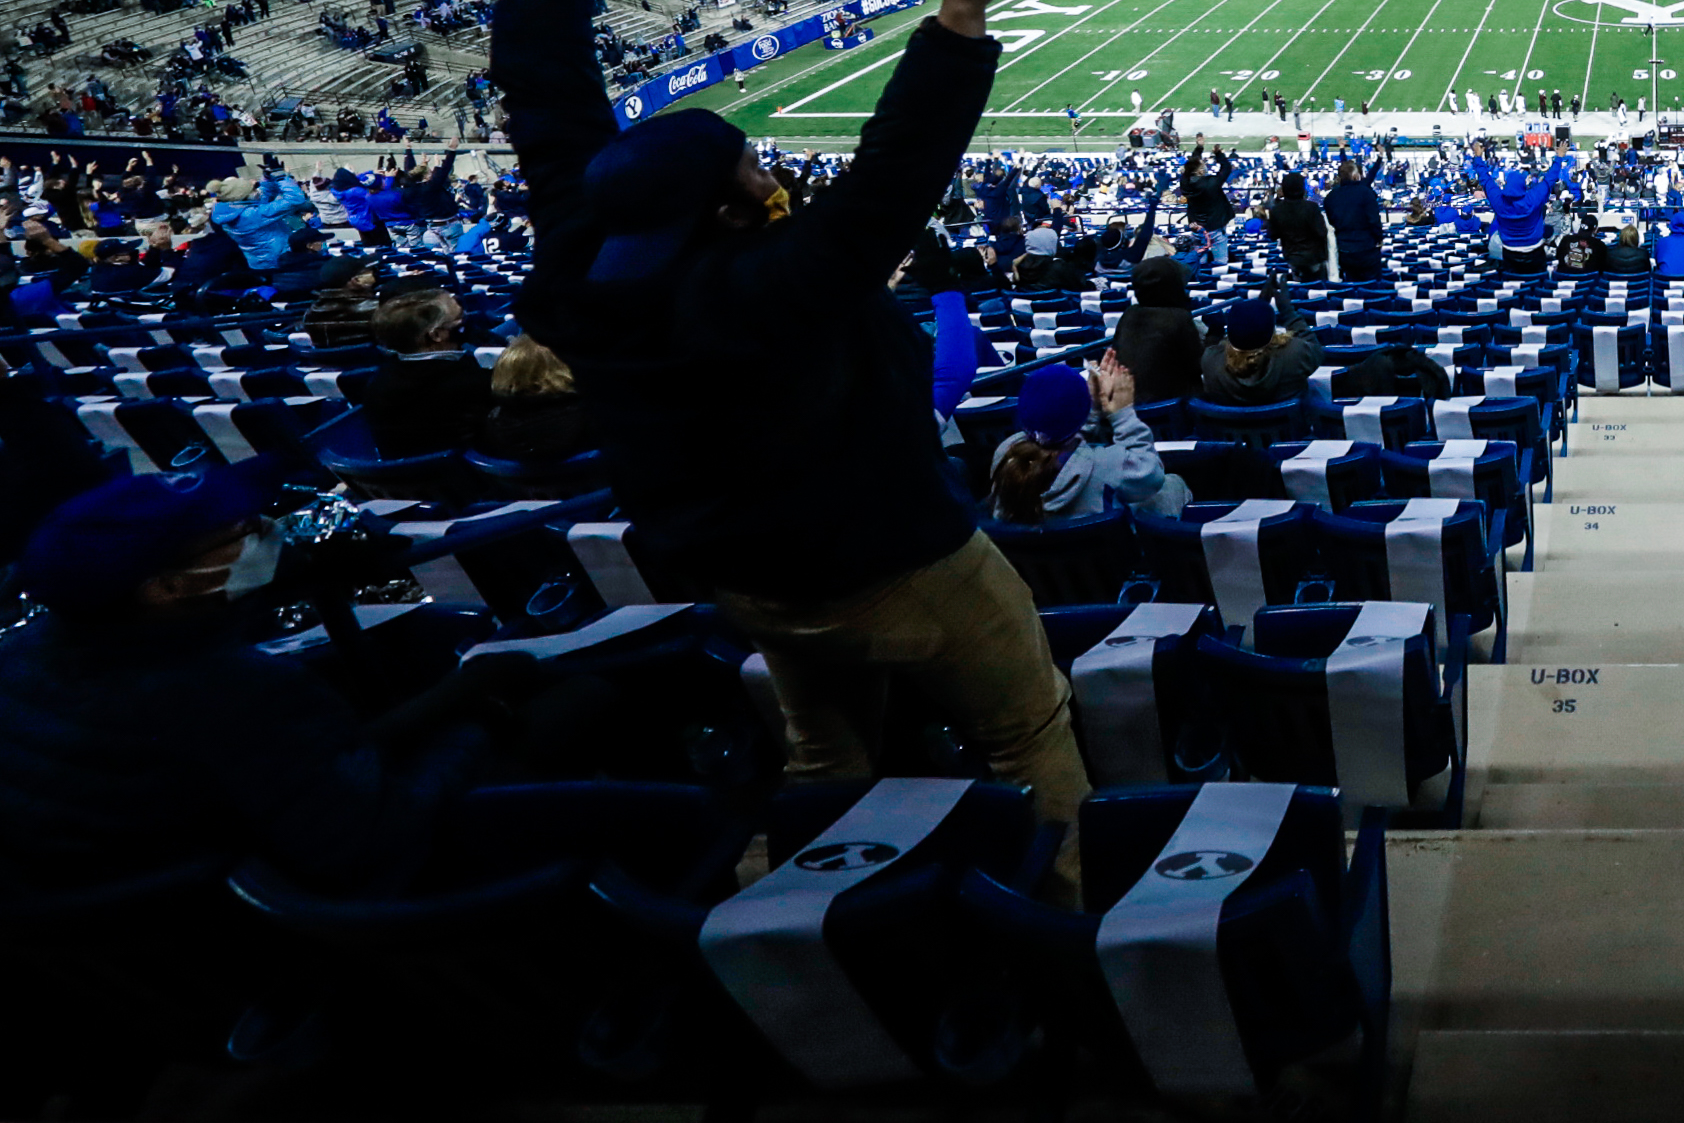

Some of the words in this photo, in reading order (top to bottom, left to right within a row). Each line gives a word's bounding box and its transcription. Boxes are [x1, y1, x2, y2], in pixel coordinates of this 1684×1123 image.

[823, 20, 840, 33] BAN
[1099, 69, 1149, 81] 10
[1230, 69, 1281, 81] 20
[1365, 69, 1412, 80] 30
[1499, 69, 1545, 80] 40
[1632, 69, 1677, 80] 50
[482, 237, 501, 255] 12
[1570, 505, 1616, 515] U-BOX
[1584, 522, 1599, 531] 34
[1530, 667, 1600, 686] U-BOX
[1552, 698, 1577, 714] 35
